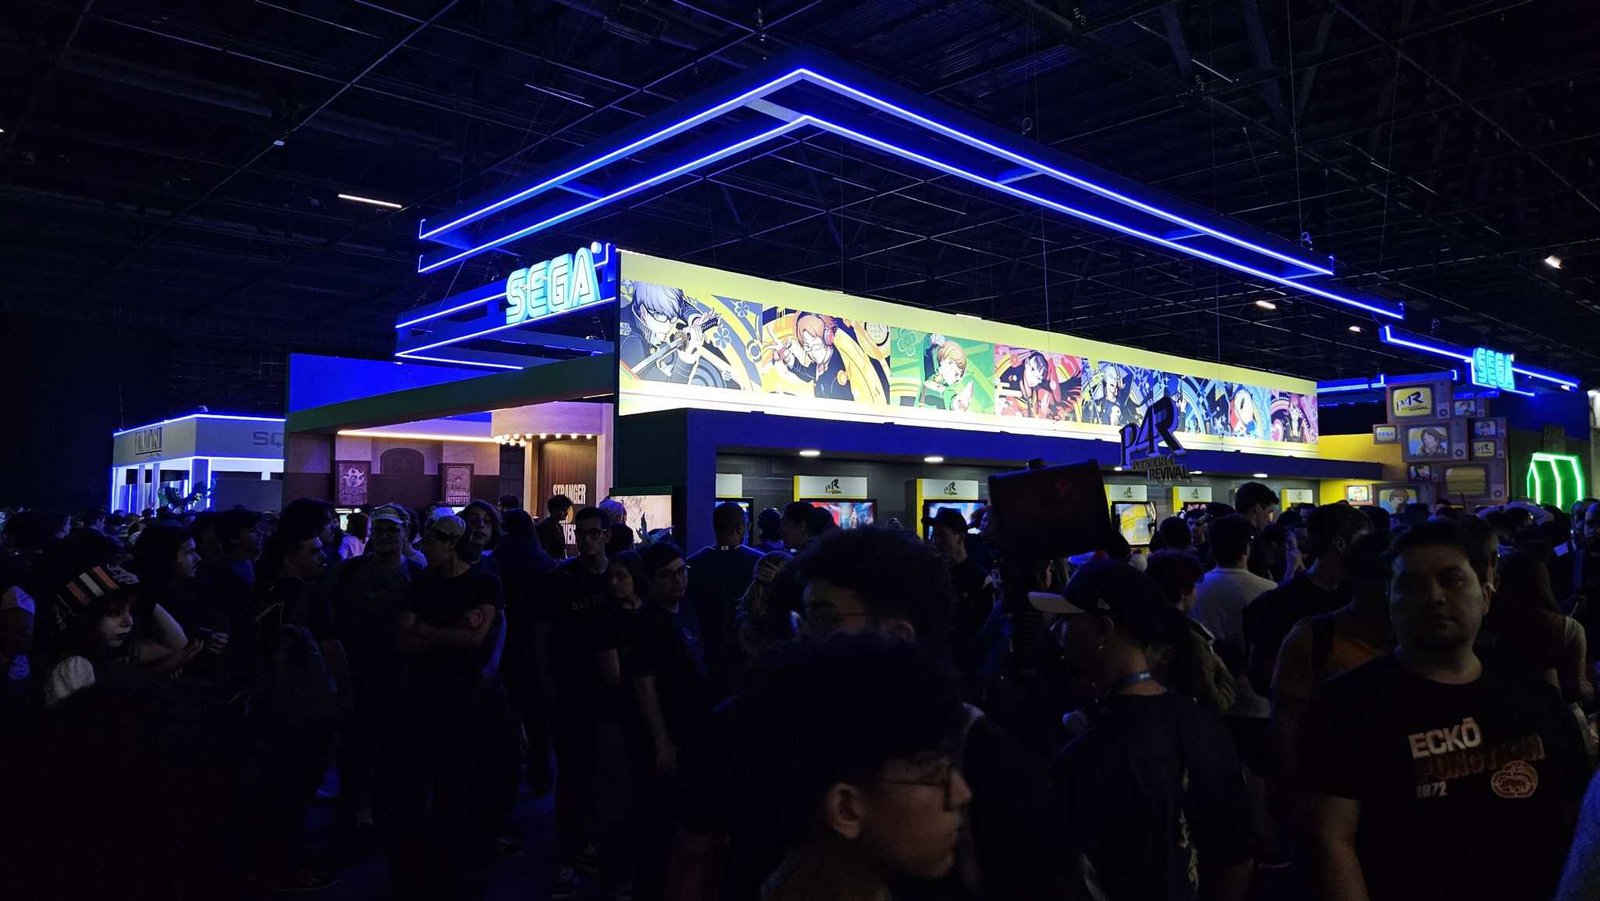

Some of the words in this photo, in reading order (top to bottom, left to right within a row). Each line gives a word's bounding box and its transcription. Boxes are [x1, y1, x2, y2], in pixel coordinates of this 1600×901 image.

[506, 246, 601, 325] SEGA
[1473, 347, 1516, 390] SEGA
[1148, 464, 1191, 481] REVIVAL
[552, 484, 587, 505] STRANGER
